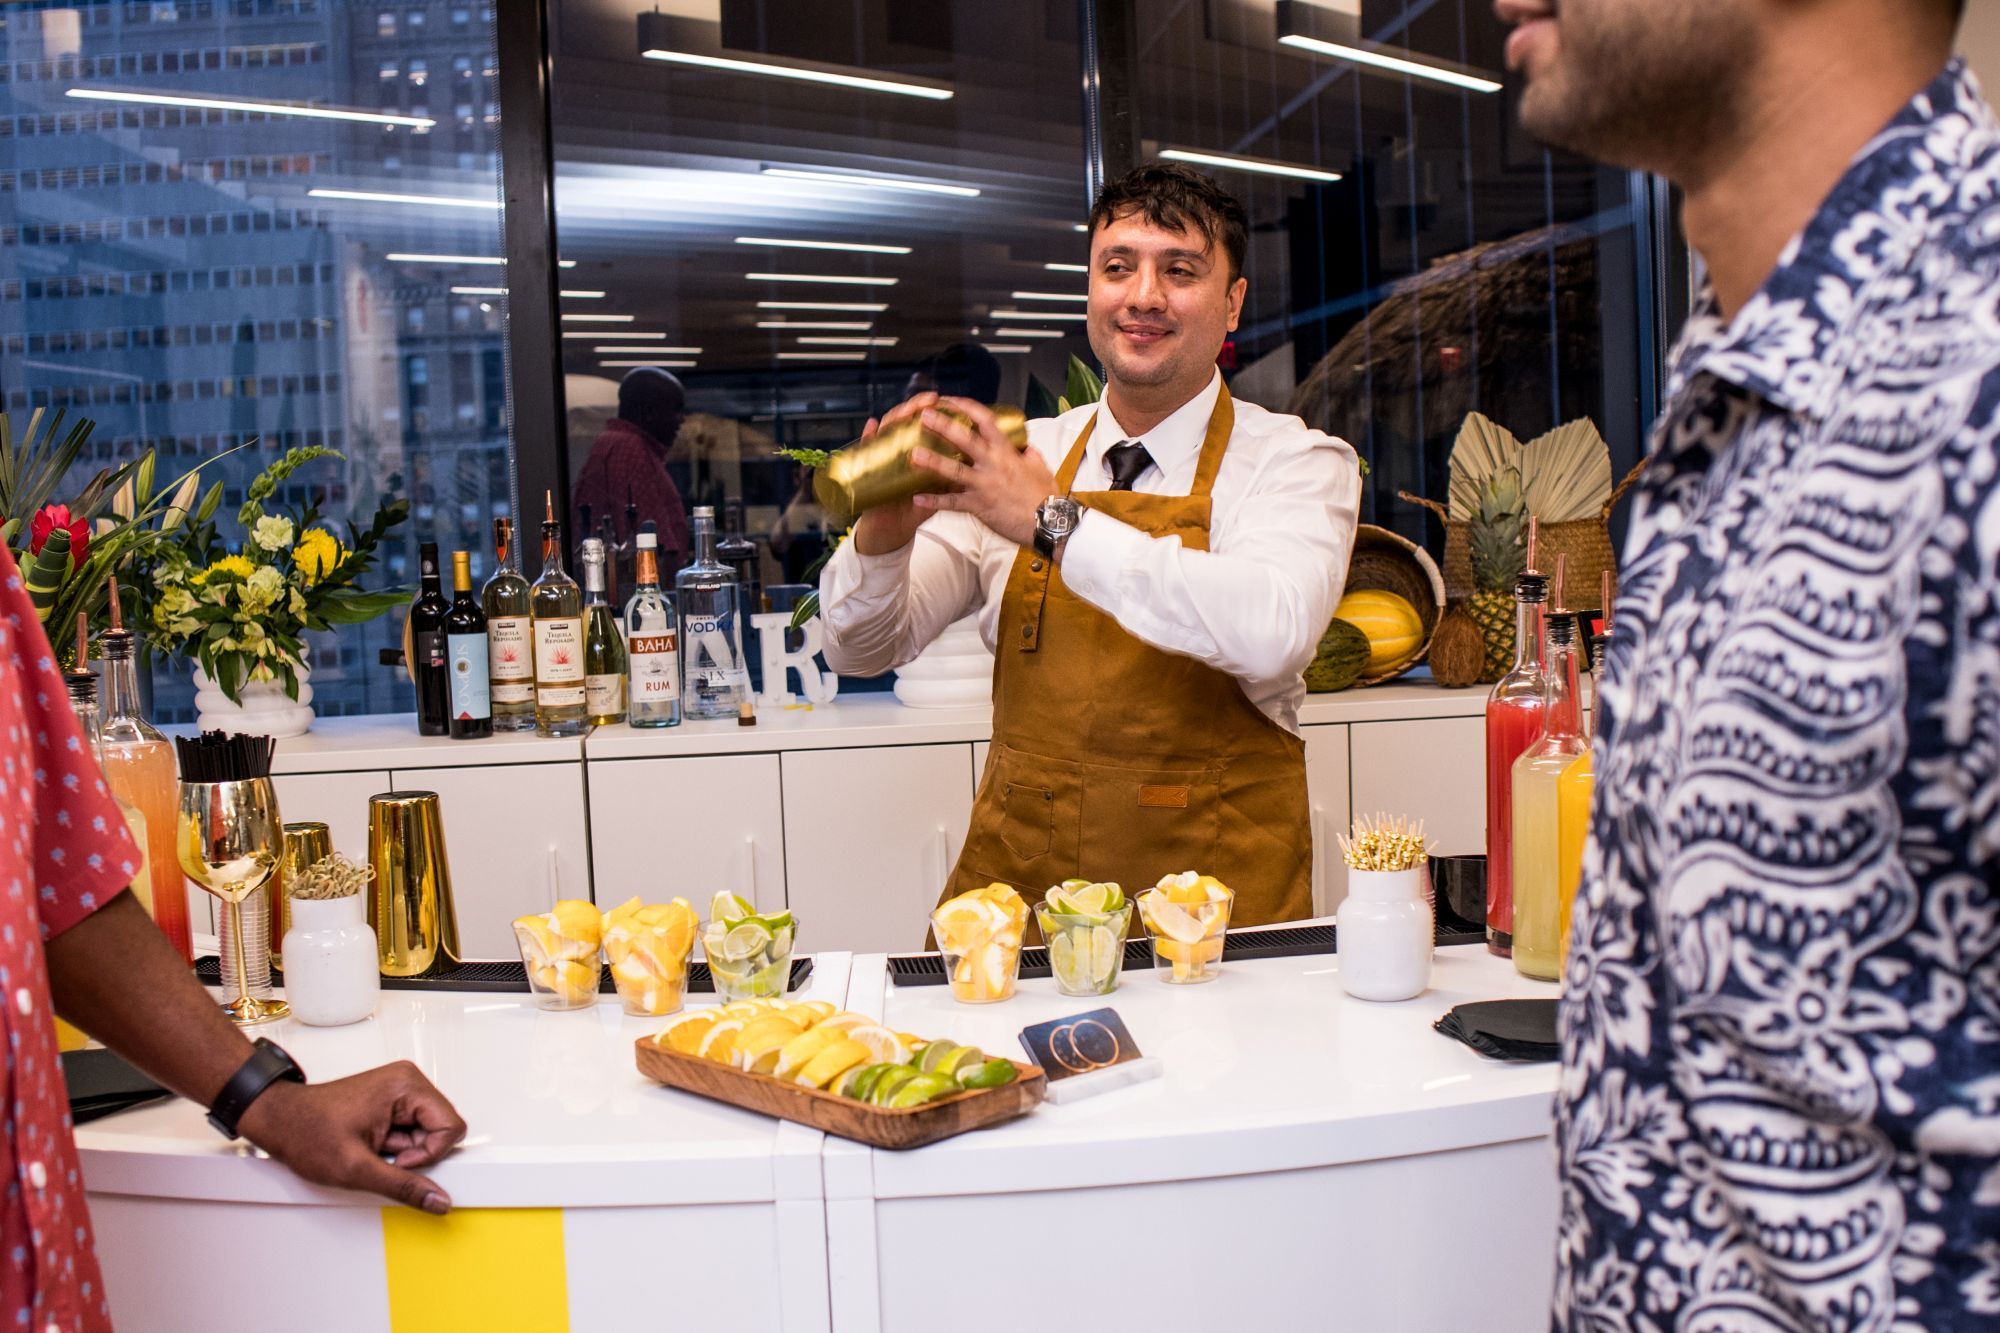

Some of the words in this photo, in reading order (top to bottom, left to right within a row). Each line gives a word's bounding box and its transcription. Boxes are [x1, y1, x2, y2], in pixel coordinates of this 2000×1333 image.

[547, 631, 572, 639] TEQUILA
[637, 638, 674, 652] BAHA
[700, 670, 725, 681] SIX
[645, 681, 671, 691] RUM
